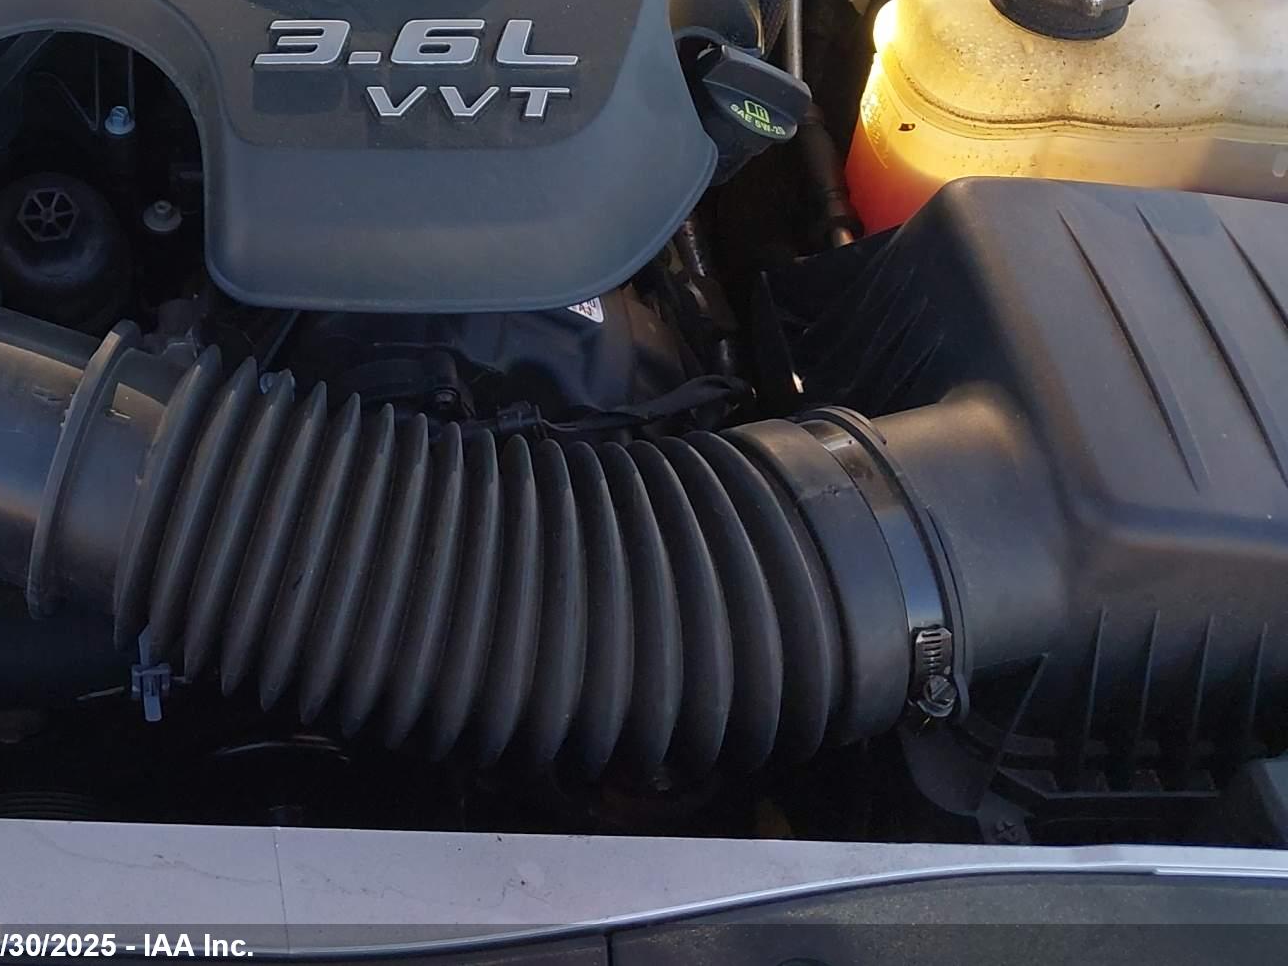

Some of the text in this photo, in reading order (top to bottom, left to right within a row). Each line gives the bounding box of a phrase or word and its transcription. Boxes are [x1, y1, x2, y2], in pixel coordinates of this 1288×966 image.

[253, 19, 580, 65] 3.6L
[366, 86, 570, 117] VVT
[730, 103, 786, 136] SAE 5W-20
